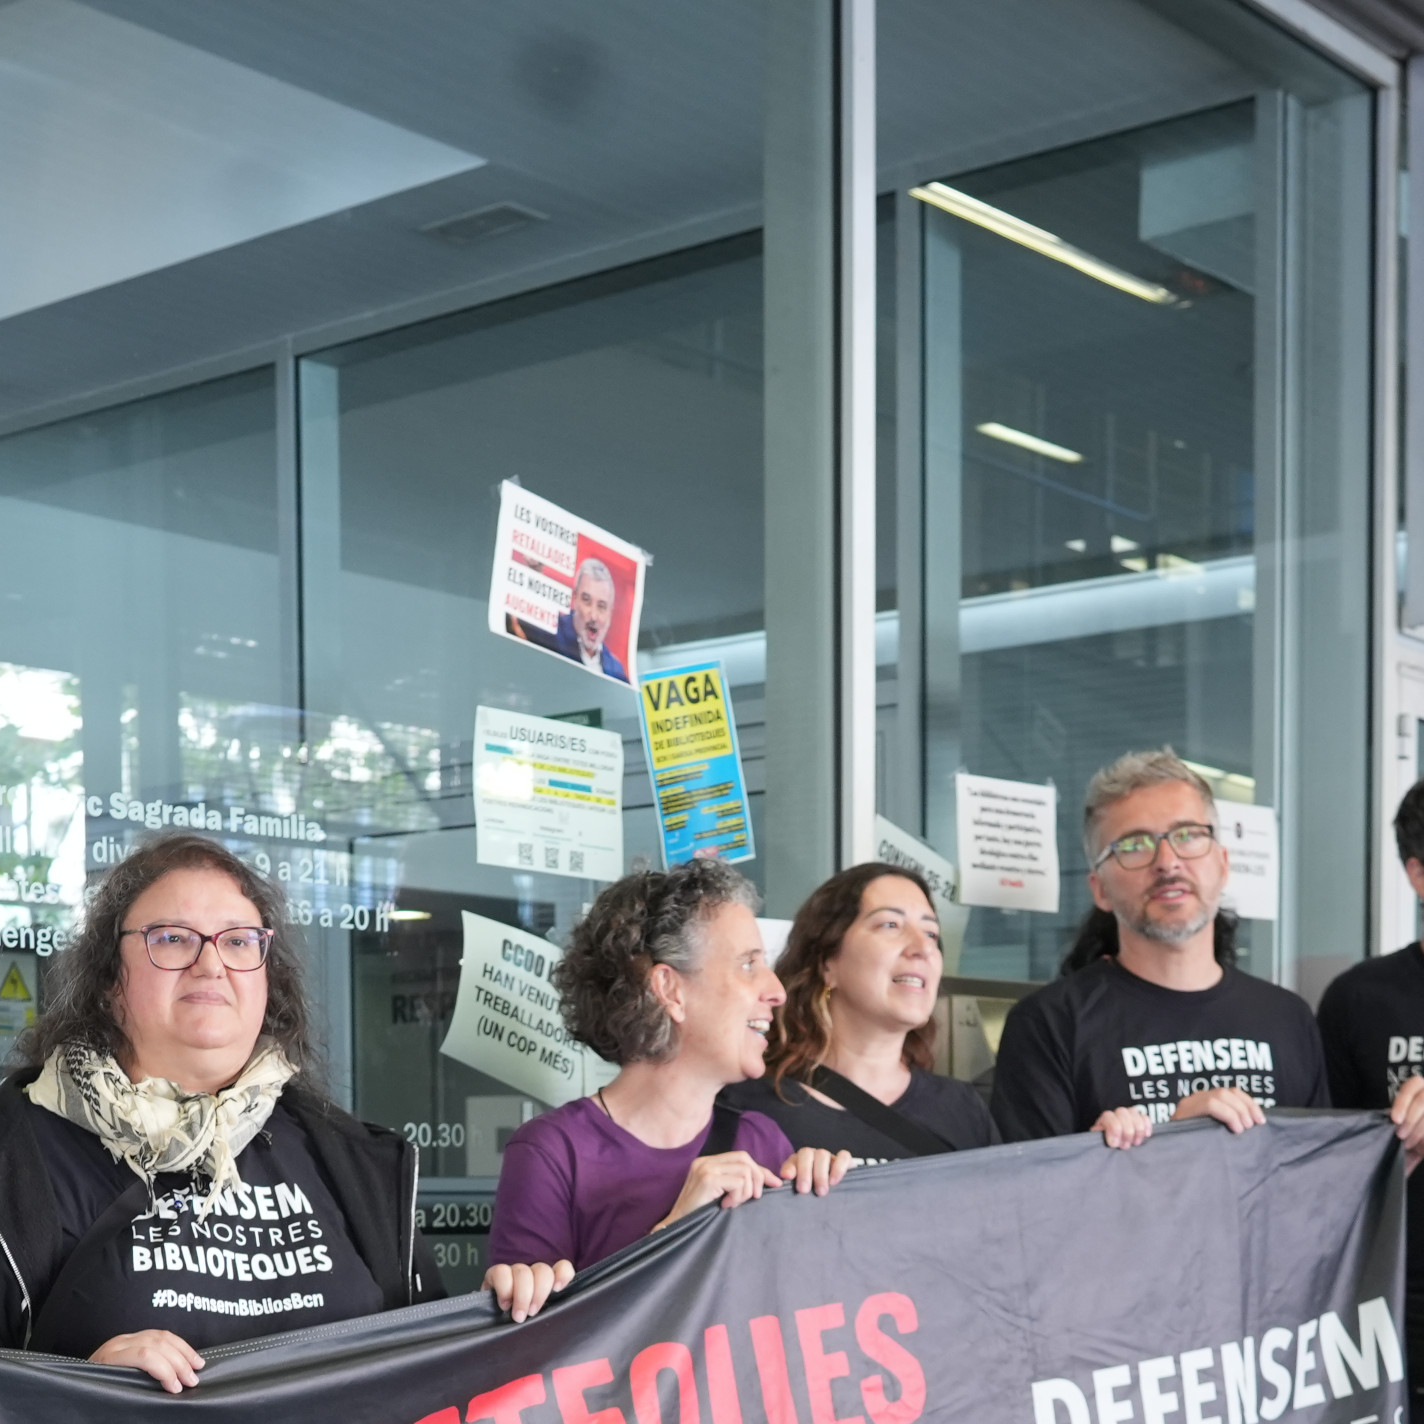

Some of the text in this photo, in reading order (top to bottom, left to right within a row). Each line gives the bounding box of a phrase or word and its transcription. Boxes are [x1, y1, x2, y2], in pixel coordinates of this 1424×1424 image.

[514, 503, 578, 547] LES VOSTRES
[507, 566, 571, 609] ELS NOSTRES
[645, 673, 719, 711] VAGA
[651, 709, 724, 736] INDEFINIDA
[509, 725, 587, 753] USUARIS/ES
[109, 792, 223, 831] Sagrada
[229, 806, 322, 842] Família
[278, 861, 292, 882] a
[299, 858, 329, 886] 21
[335, 859, 350, 888] h
[319, 908, 333, 928] a
[339, 904, 370, 931] 20
[501, 938, 545, 978] CCOO
[482, 962, 515, 992] HAN
[476, 1014, 575, 1081] (UN COP MÉS)
[1121, 1037, 1274, 1078] DEFENSEM
[1128, 1079, 1171, 1100] LES
[403, 1122, 465, 1148] 20.30
[432, 1203, 492, 1228] 20.30
[191, 1219, 323, 1247] NOSTRES
[132, 1242, 333, 1282] BIBLIOTEQUES
[467, 1242, 480, 1266] h
[152, 1289, 325, 1317] #DefensemBibliosBcn
